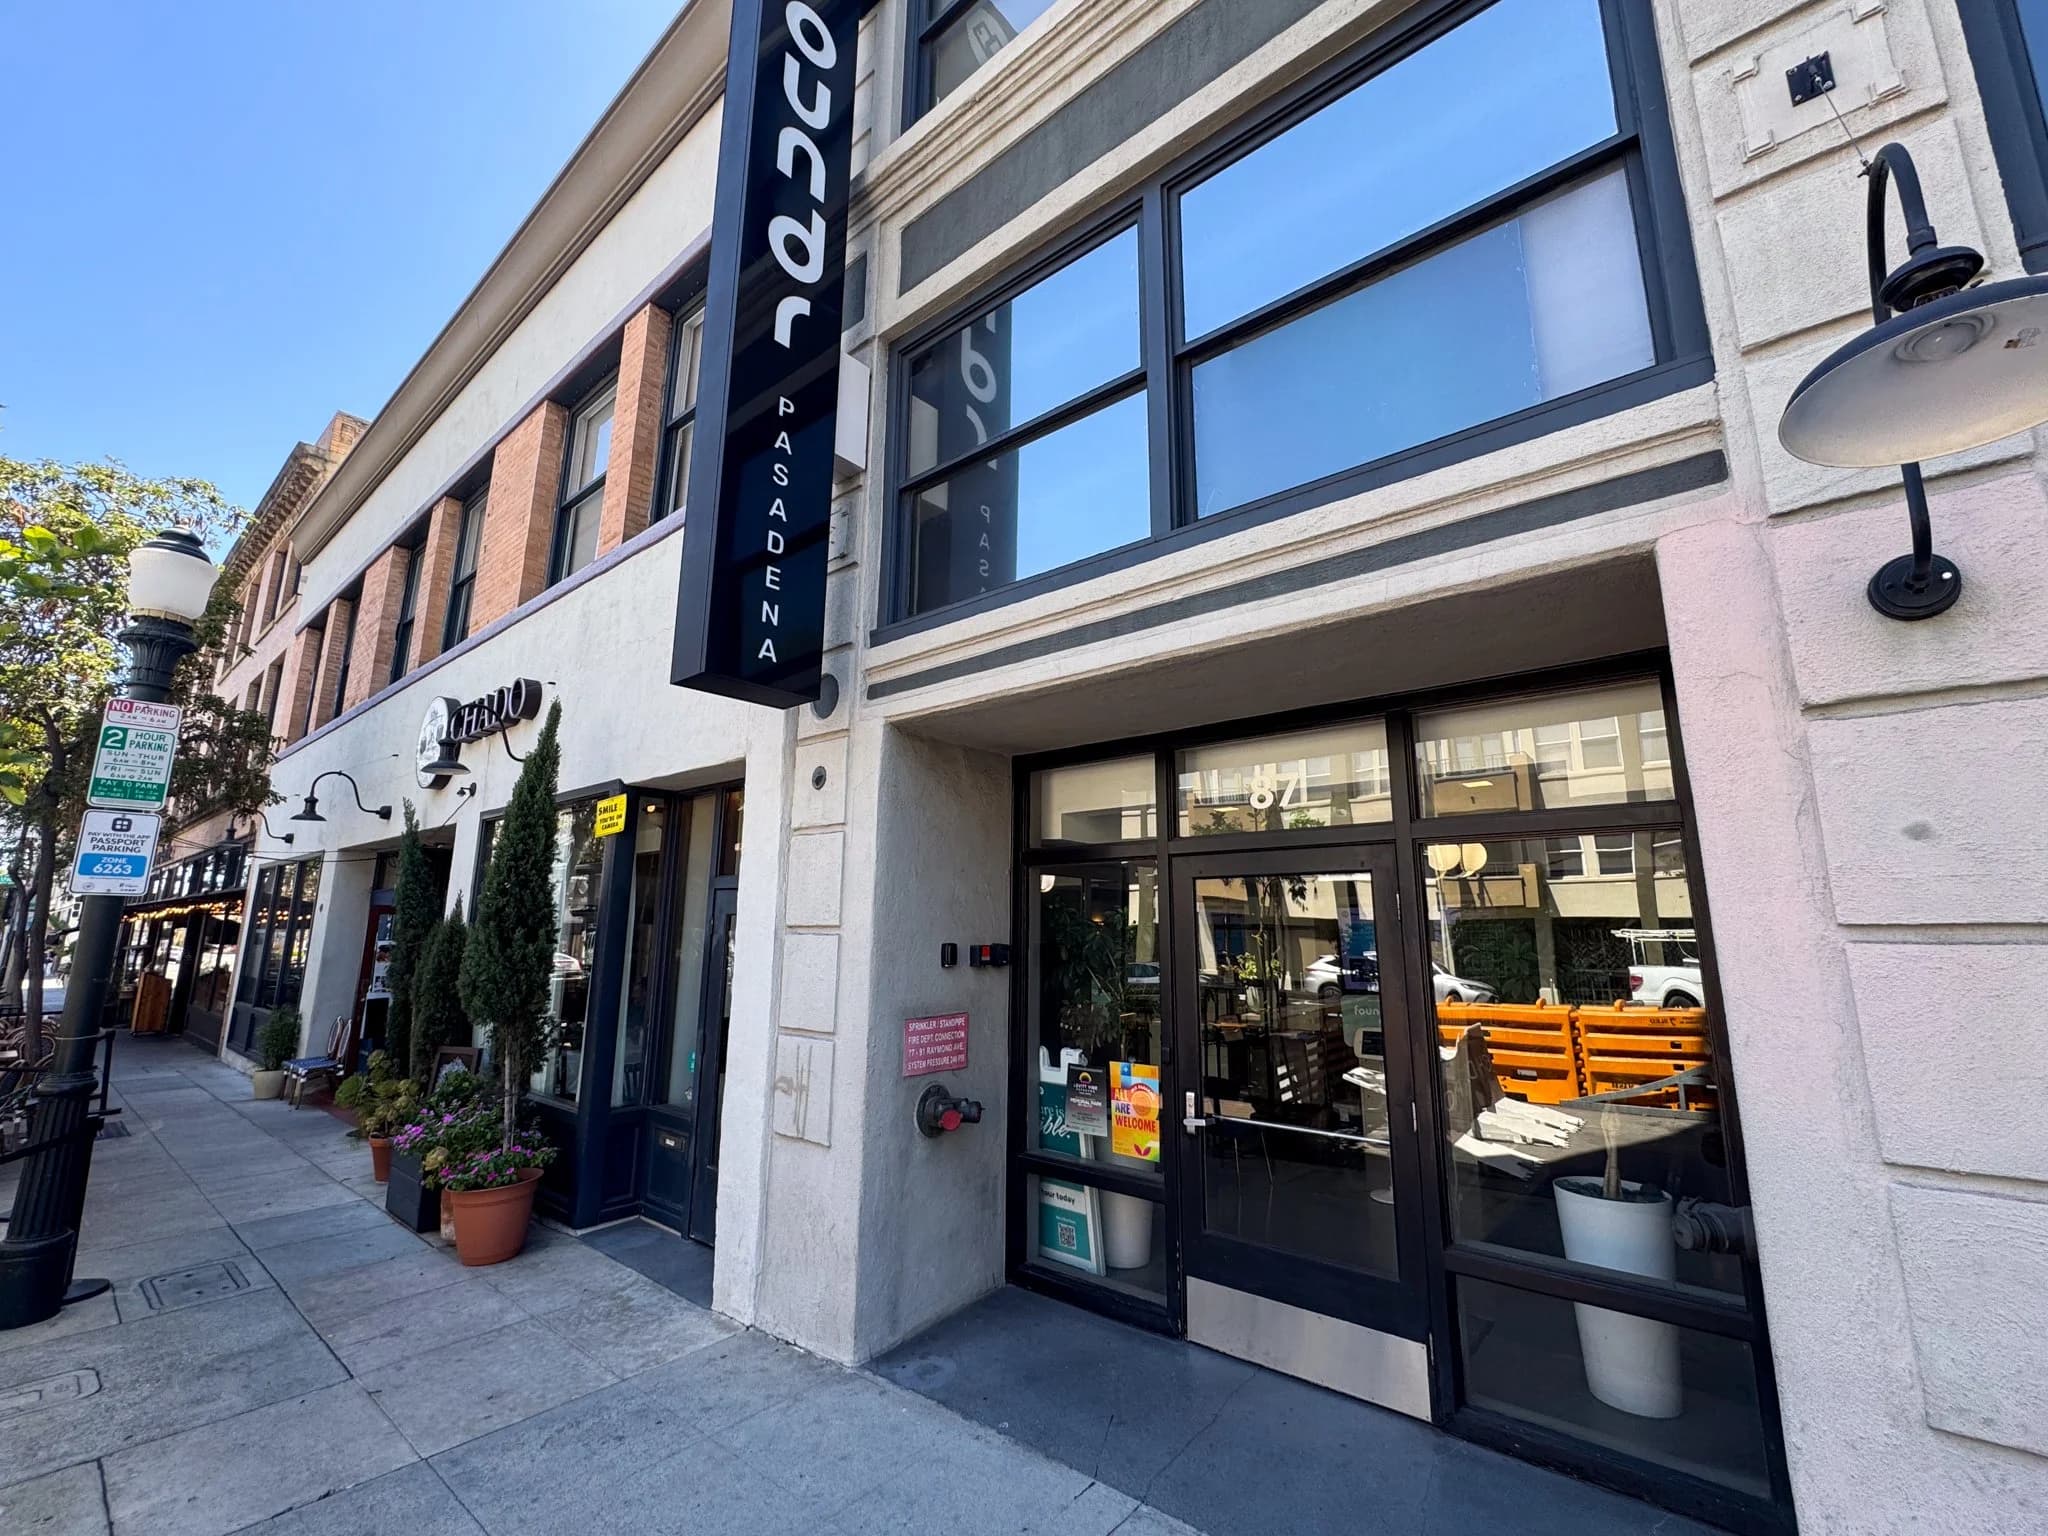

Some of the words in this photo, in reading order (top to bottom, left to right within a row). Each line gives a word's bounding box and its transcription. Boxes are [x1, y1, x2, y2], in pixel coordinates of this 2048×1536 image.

[758, 396, 795, 663] PASADENA
[111, 700, 130, 712] NO
[134, 705, 176, 718] PARKING
[450, 677, 536, 742] CHADO
[105, 729, 124, 747] 2
[135, 732, 167, 742] HOUR
[129, 740, 169, 753] PARKING
[106, 750, 129, 758] SUN
[138, 753, 165, 761] THUR
[100, 779, 118, 787] PAY
[1250, 772, 1299, 809] 87
[598, 804, 618, 816] SMILE
[89, 836, 146, 847] PASSPORT
[91, 844, 142, 854] PARKING
[101, 856, 128, 864] ZONE
[92, 864, 133, 875] 6263
[908, 1036, 920, 1045] FIRE
[934, 1031, 965, 1042] CONNECTION
[926, 1044, 952, 1055] RAYMOND
[908, 1061, 926, 1071] SYSTEM
[926, 1056, 950, 1067] PRESSURE
[1114, 1088, 1129, 1101] ALL
[1115, 1101, 1131, 1115] ARE
[1115, 1114, 1156, 1133] WELCOME
